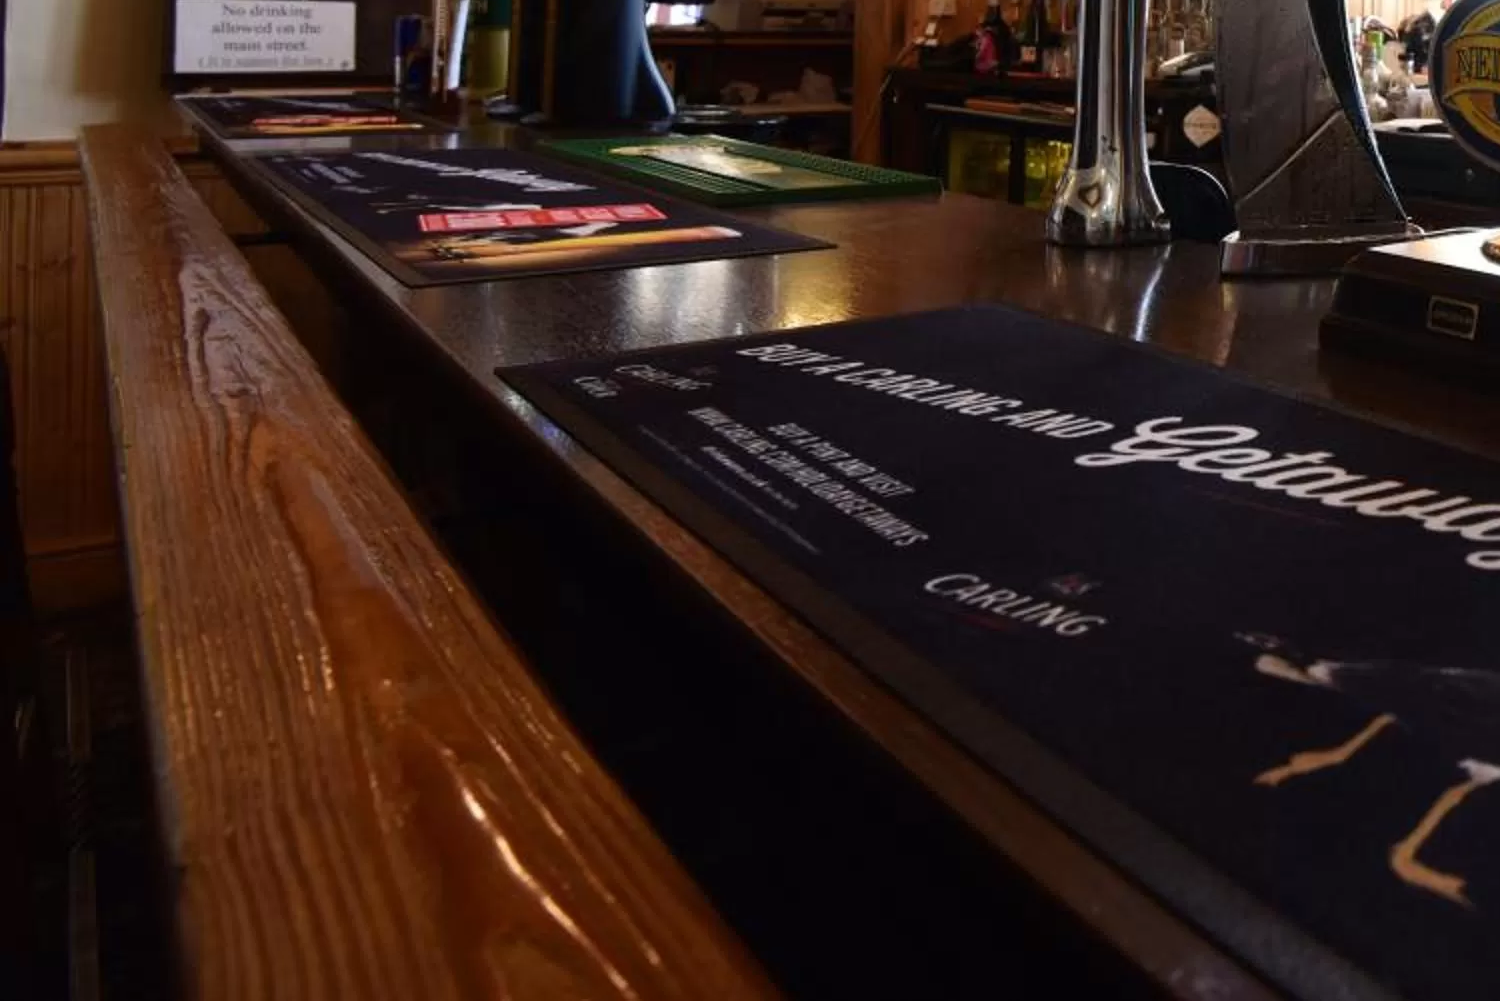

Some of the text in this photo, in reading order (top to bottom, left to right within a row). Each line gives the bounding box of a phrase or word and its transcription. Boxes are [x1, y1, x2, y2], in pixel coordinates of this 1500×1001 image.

[211, 22, 321, 35] allowed on the
[222, 3, 313, 19] No drinking
[738, 343, 1116, 439] BUY A CARLING AND
[922, 572, 1108, 638] CARLING
